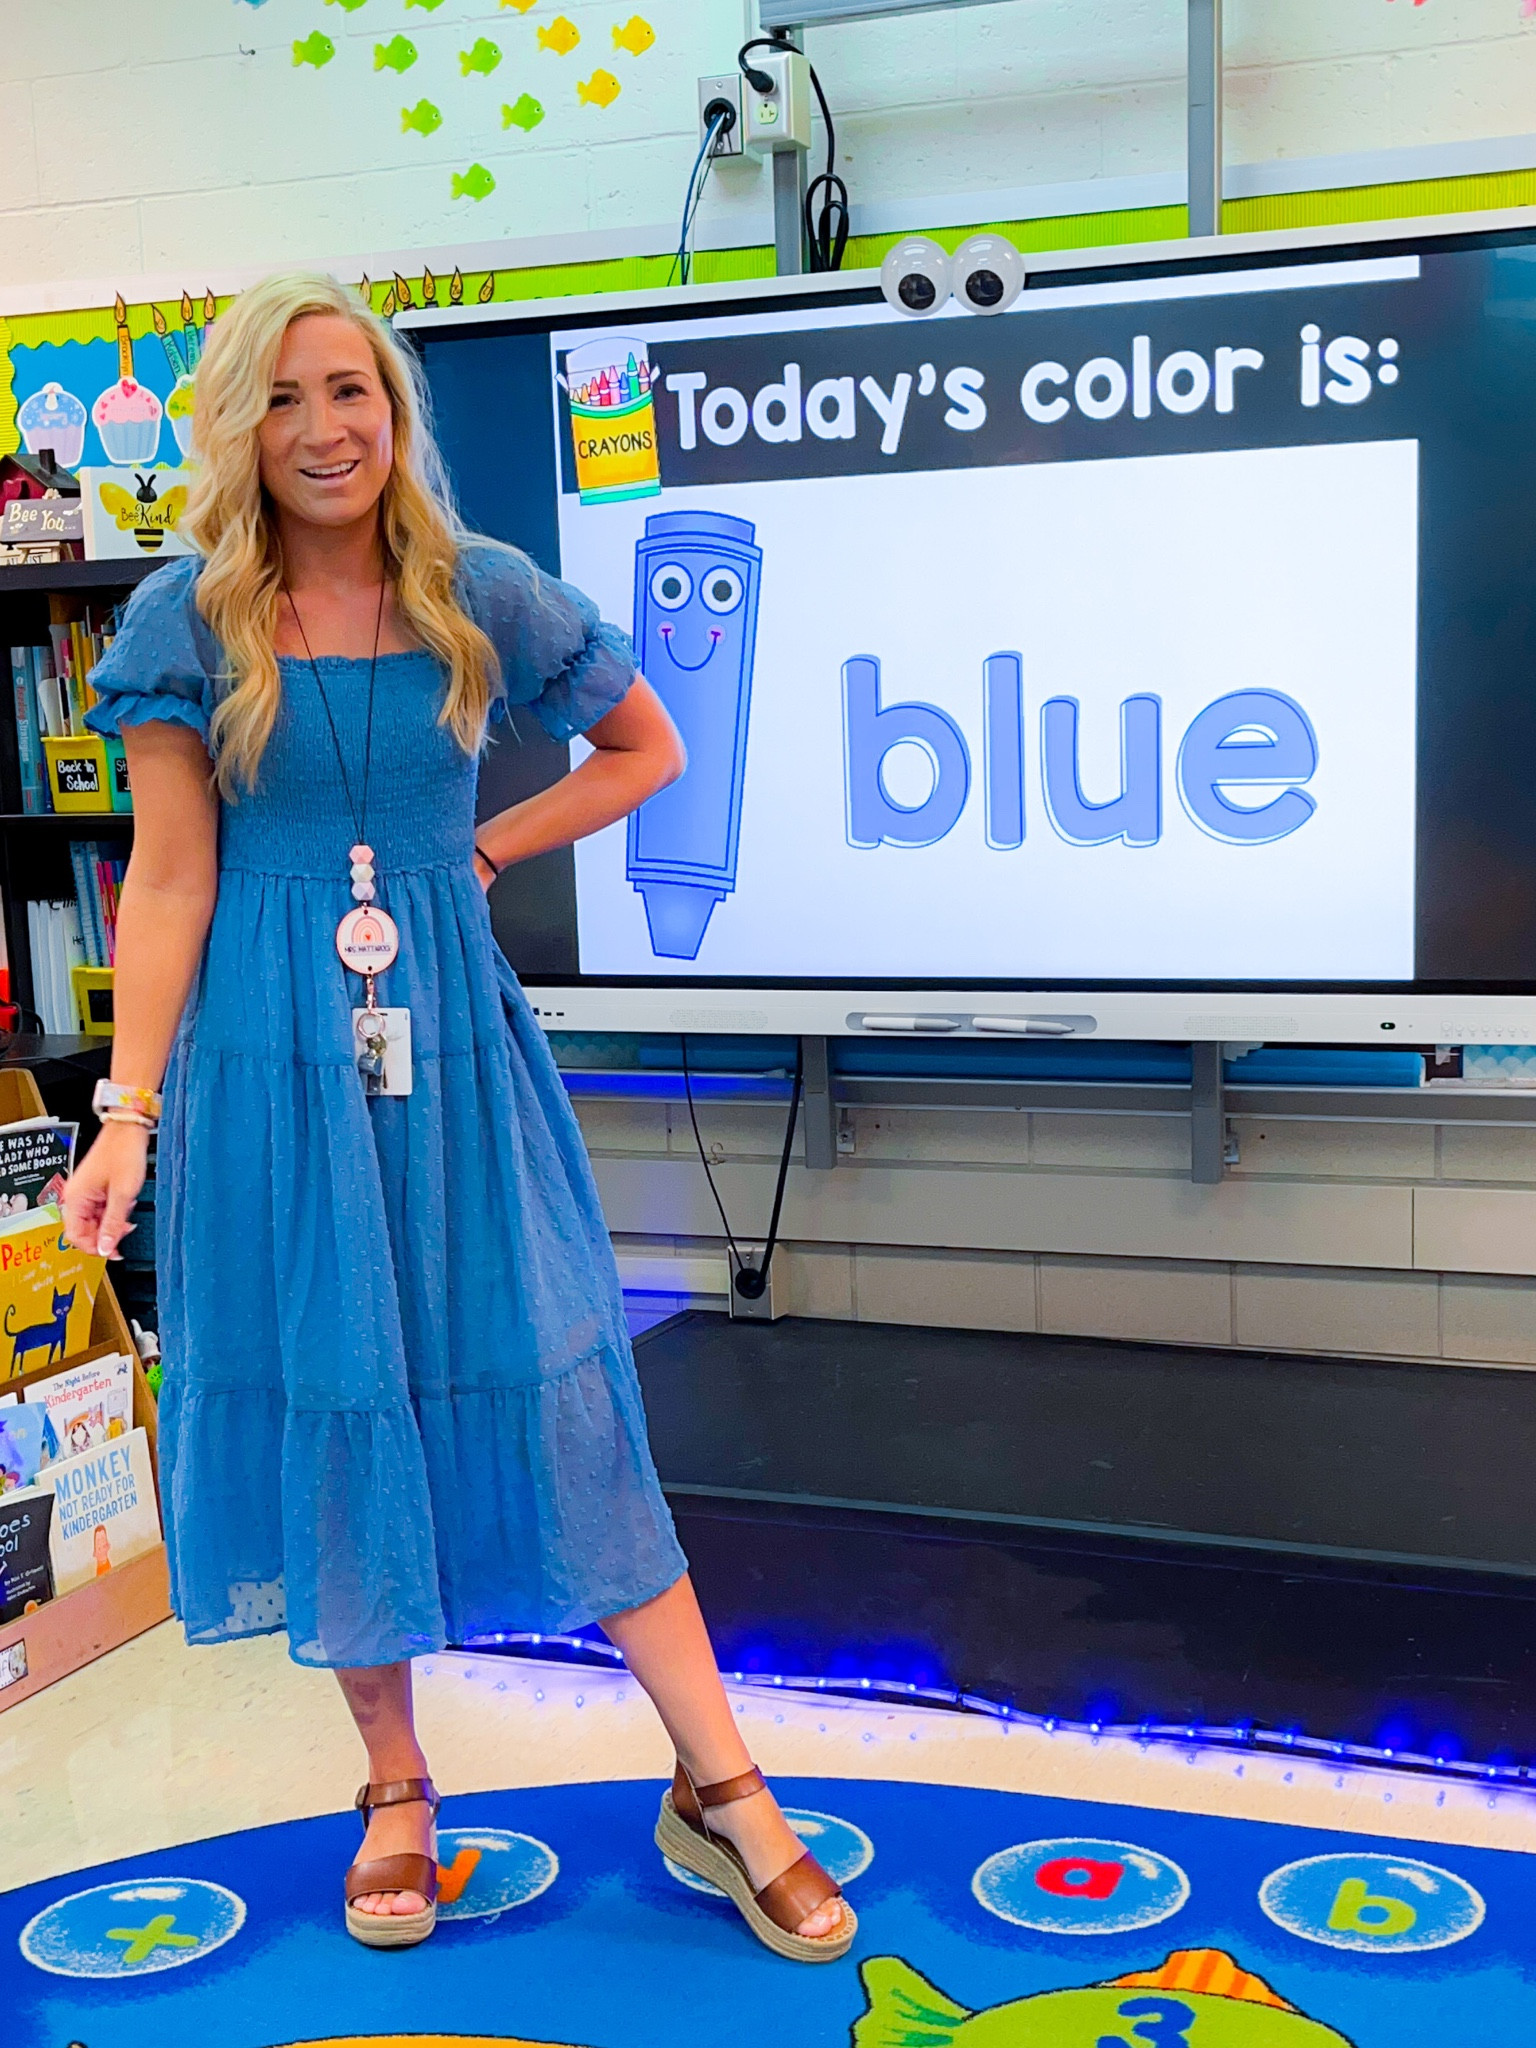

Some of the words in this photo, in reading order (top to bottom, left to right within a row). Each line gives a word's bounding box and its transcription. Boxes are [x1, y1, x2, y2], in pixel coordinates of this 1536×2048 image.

[666, 362, 987, 454] Today's
[1020, 334, 1264, 424] color
[1300, 323, 1399, 408] is:
[578, 430, 653, 459] CRAYONS
[8, 503, 38, 522] Bee
[121, 507, 139, 521] Bee
[135, 503, 175, 528] Kind
[841, 650, 1320, 851] blue
[57, 759, 82, 773] Back
[84, 759, 95, 773] to
[66, 773, 99, 791] School
[0, 1150, 23, 1164] LADY
[26, 1145, 49, 1159] WHO
[8, 1135, 33, 1150] WAS
[36, 1133, 55, 1145] AN
[8, 1160, 32, 1175] SOME
[33, 1154, 67, 1170] BOOKS!
[1, 1241, 42, 1271] Pete
[44, 1378, 111, 1408] Kindergarten
[53, 1382, 63, 1391] The
[65, 1376, 80, 1387] Night
[54, 1444, 130, 1504] MONKEY
[59, 1498, 79, 1522] NOT
[82, 1482, 113, 1511] READY
[115, 1473, 135, 1494] FOR
[62, 1490, 138, 1540] KINDERGARTEN
[1035, 1857, 1125, 1899] a
[1327, 1878, 1416, 1936] b
[106, 1914, 199, 1963] x
[1097, 1996, 1196, 2048] 3
